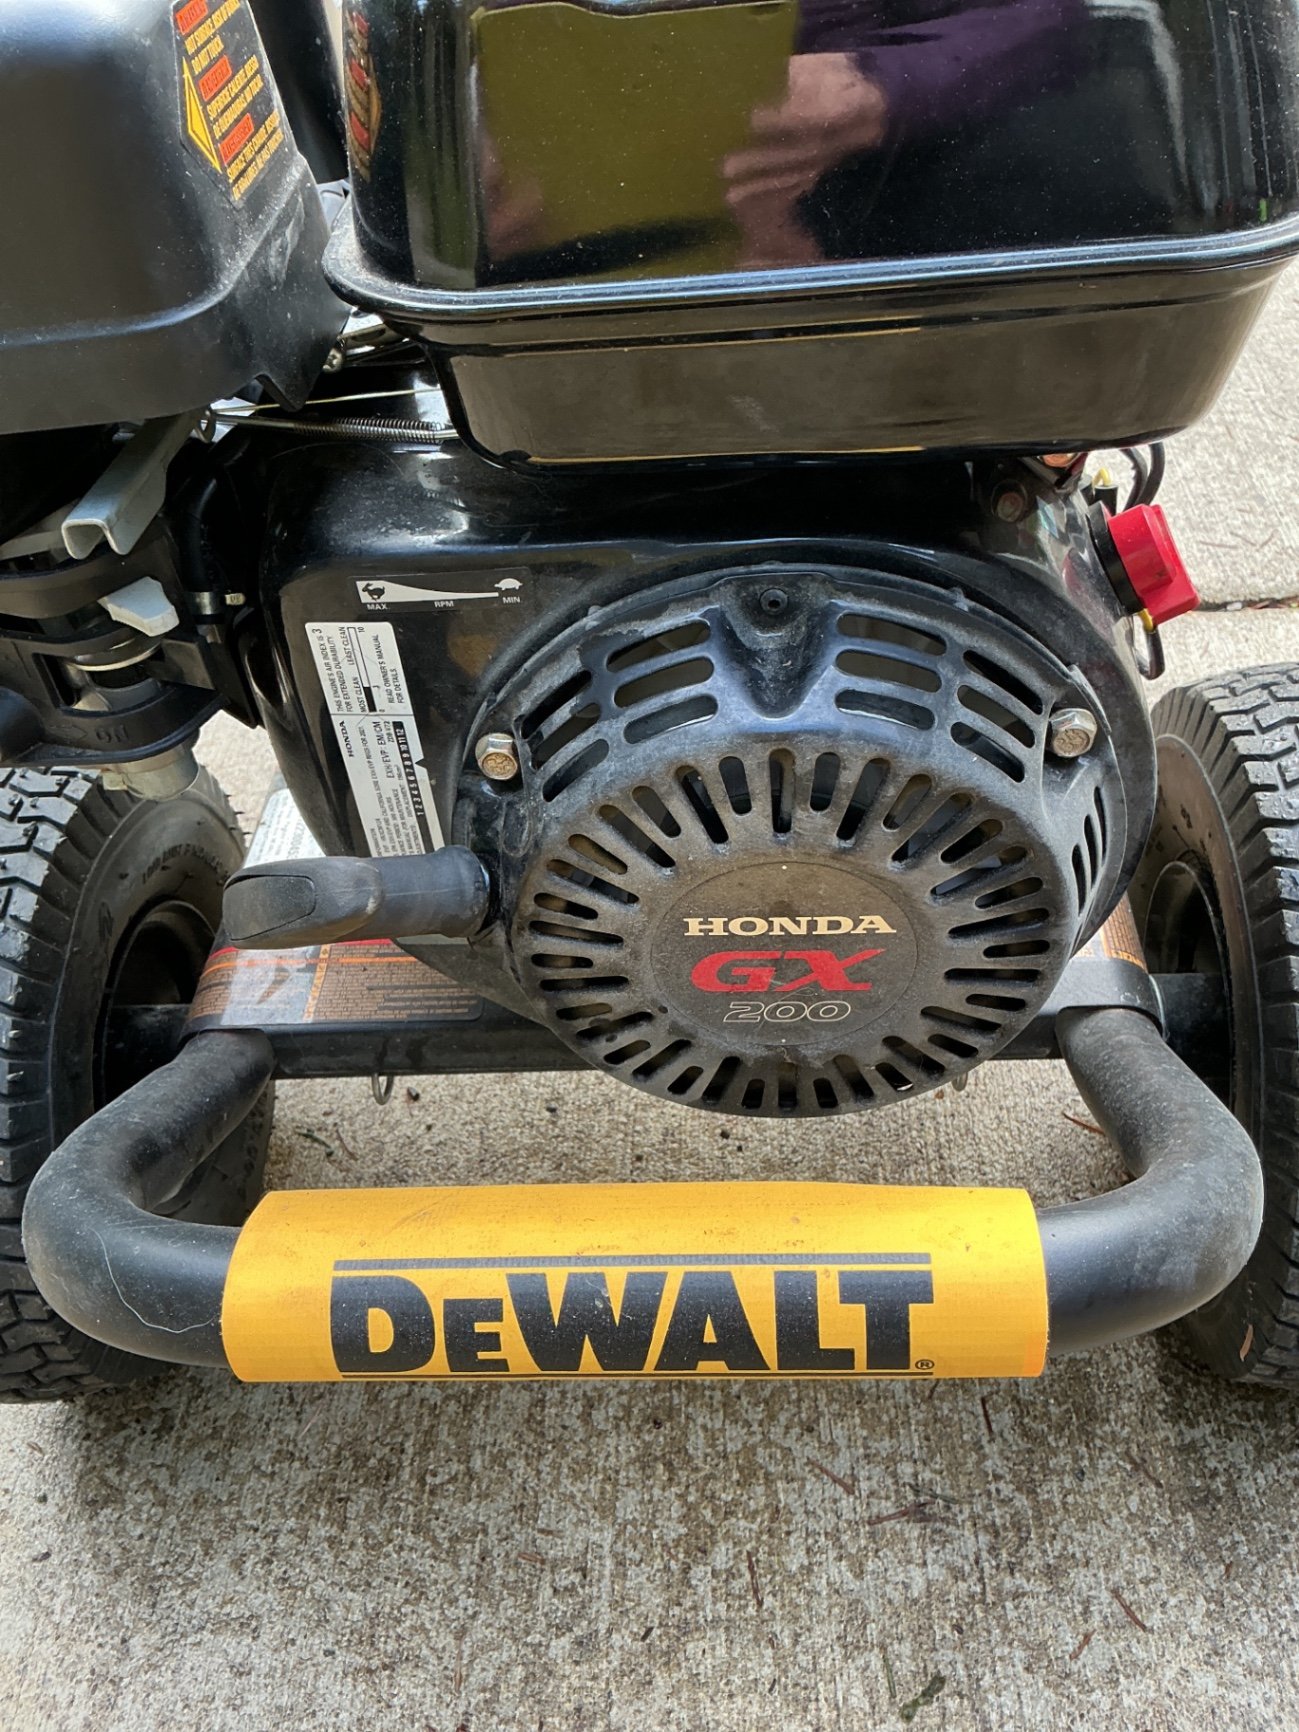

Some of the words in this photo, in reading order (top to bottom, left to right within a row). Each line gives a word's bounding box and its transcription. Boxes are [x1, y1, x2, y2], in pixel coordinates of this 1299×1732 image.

[434, 600, 454, 608] RPM
[339, 627, 349, 646] CLEAN
[319, 643, 330, 660] INDEX
[372, 635, 384, 659] MANUAL
[344, 648, 354, 665] LEAST
[325, 662, 333, 671] AIR
[379, 661, 391, 687] OWNER'S
[337, 671, 350, 699] EXTENDED
[353, 677, 362, 695] CLEAN
[358, 697, 367, 712] MOST
[386, 689, 395, 703] READ
[397, 693, 405, 703] FOR
[336, 701, 344, 712] THIS
[339, 720, 354, 757] HONDA
[683, 915, 897, 936] HONDA
[690, 949, 886, 993] GX
[723, 1000, 852, 1023] 200
[330, 1269, 935, 1373] DEWALT
